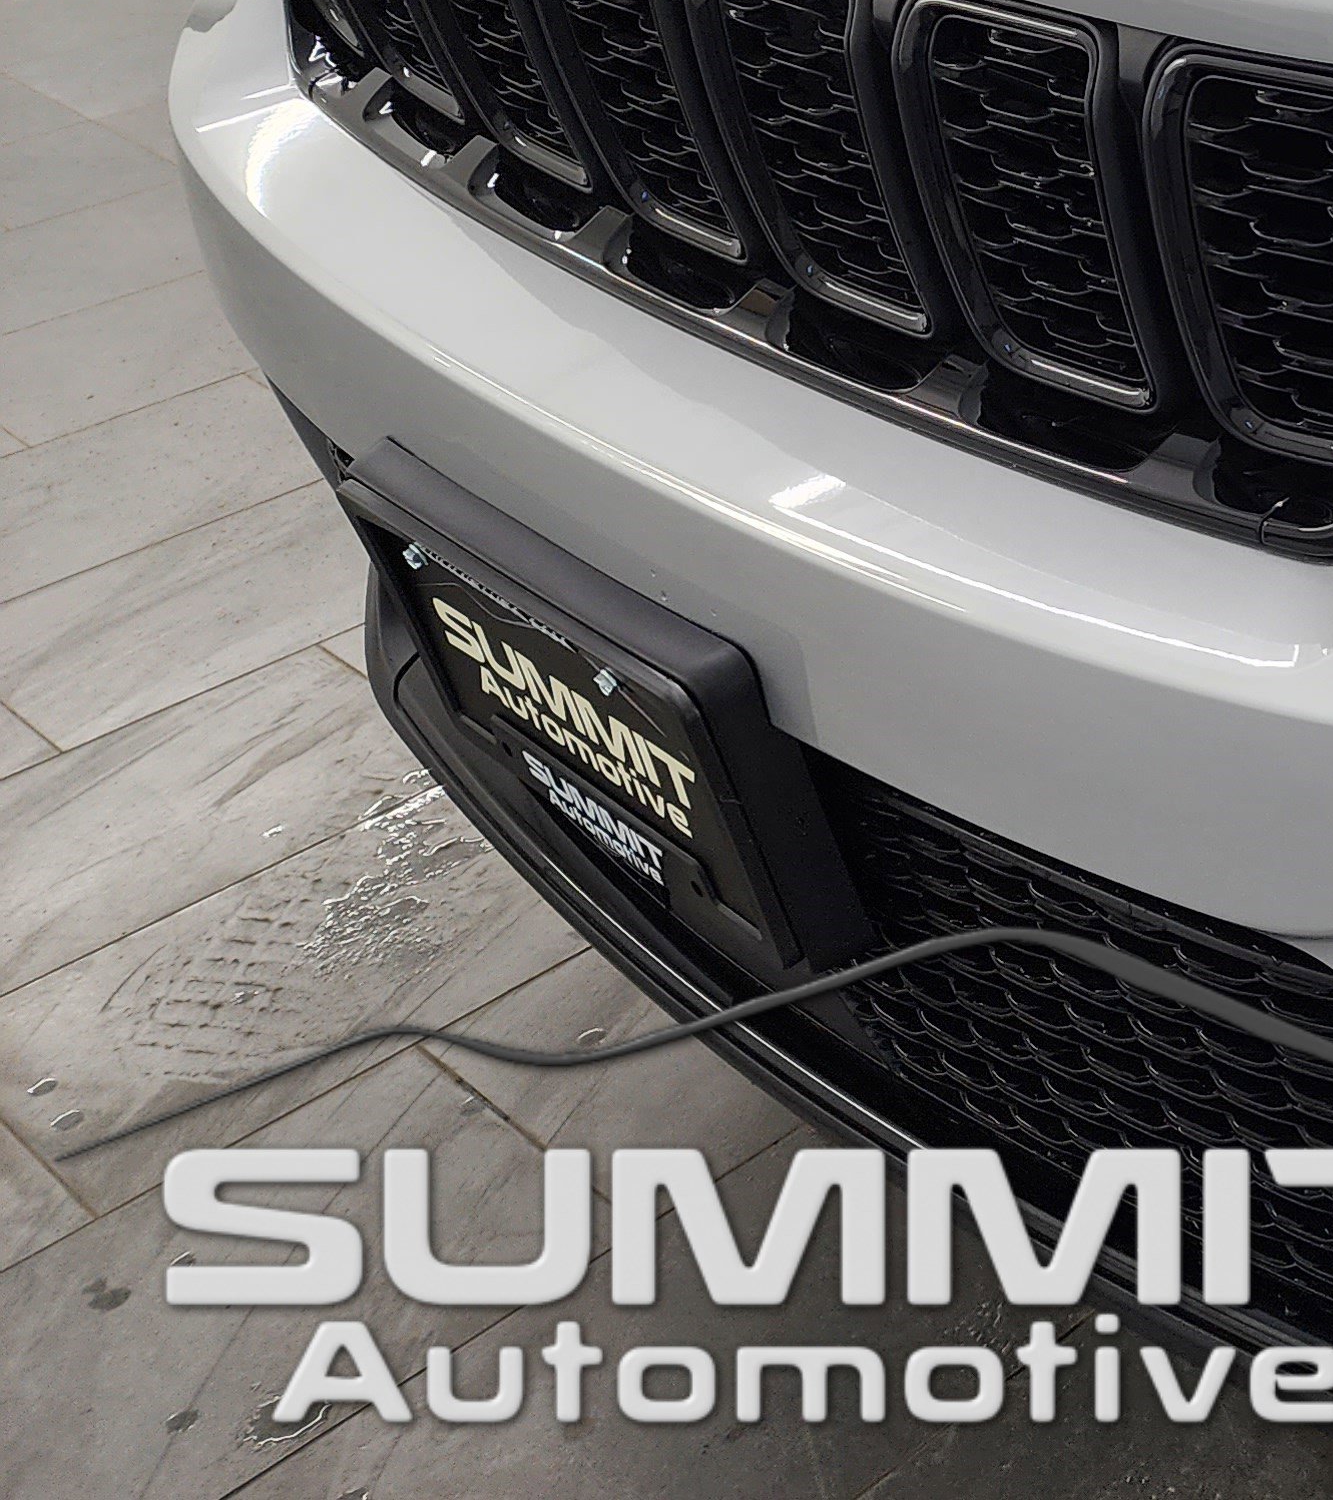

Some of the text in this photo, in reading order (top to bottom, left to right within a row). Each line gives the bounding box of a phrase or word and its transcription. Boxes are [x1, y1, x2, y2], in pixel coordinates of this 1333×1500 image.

[433, 597, 695, 809] SUMMIT
[480, 665, 693, 838] Automotive
[522, 750, 663, 869] SUMMIT
[548, 785, 664, 887] Automotive
